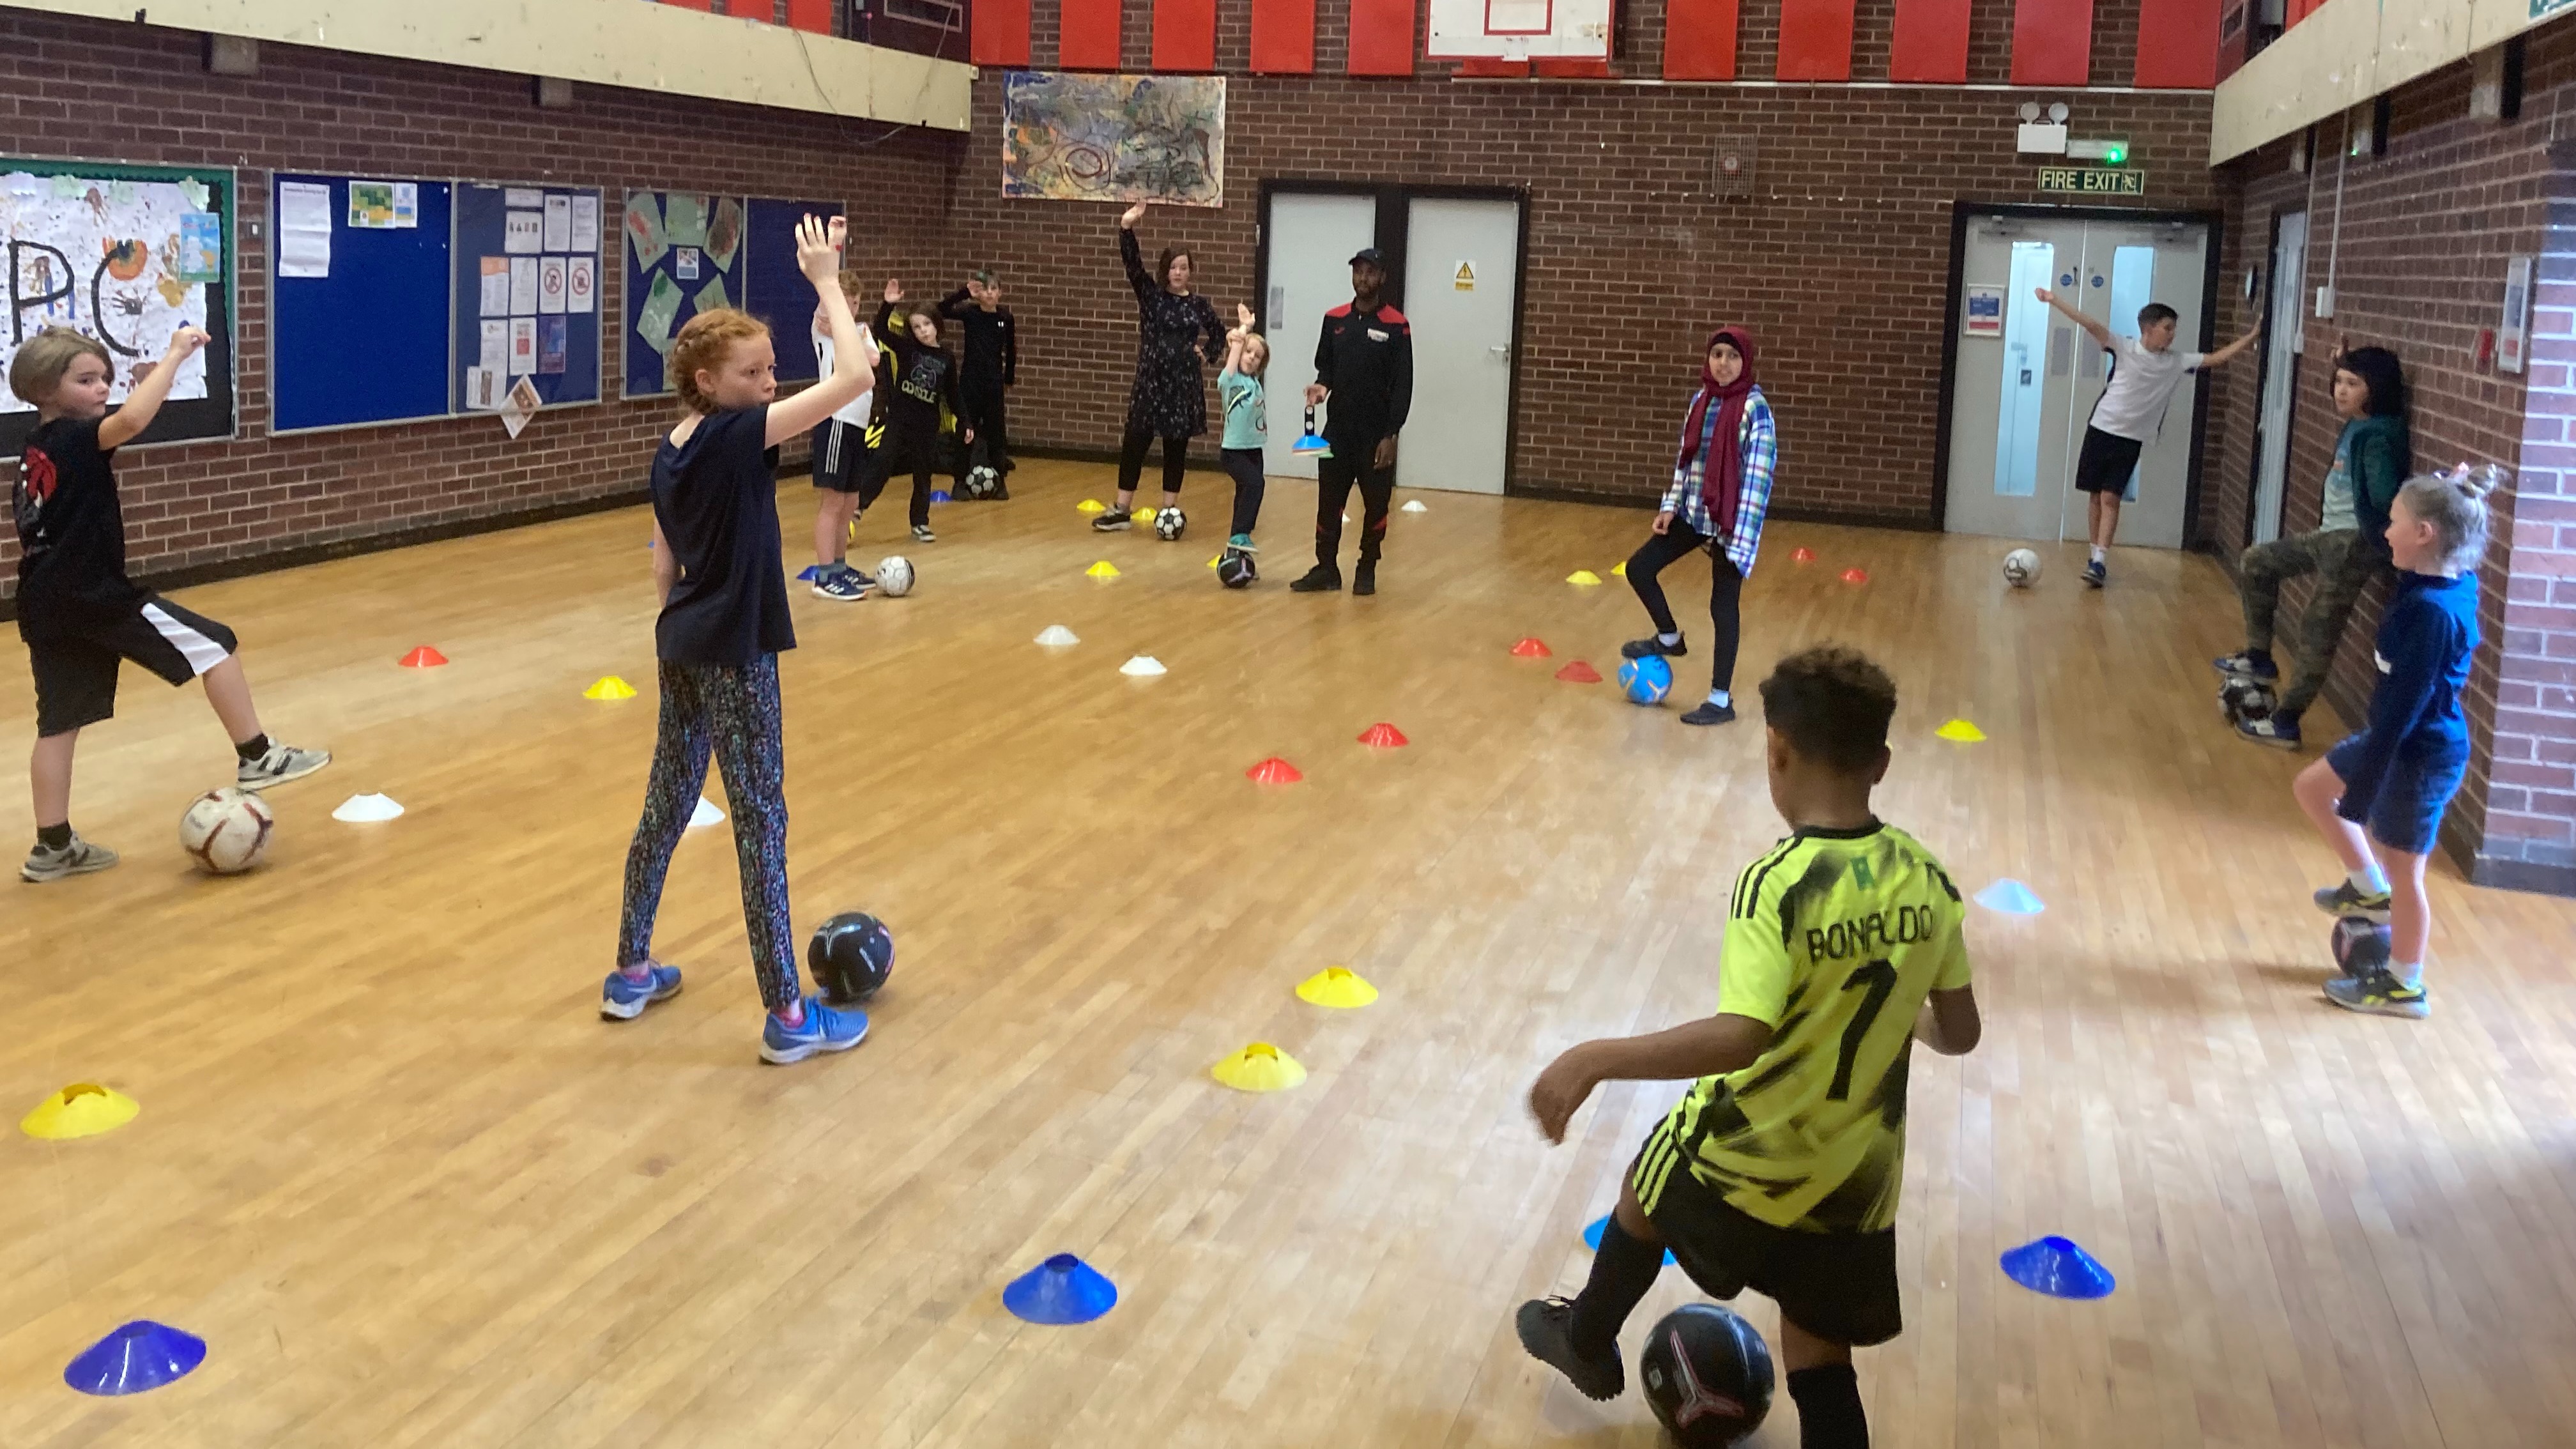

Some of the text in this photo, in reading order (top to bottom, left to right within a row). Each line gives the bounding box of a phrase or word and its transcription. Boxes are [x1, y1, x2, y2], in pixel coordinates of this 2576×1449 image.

[2041, 170, 2120, 192] FIRE EXIT
[1825, 958, 1898, 1101] 7
